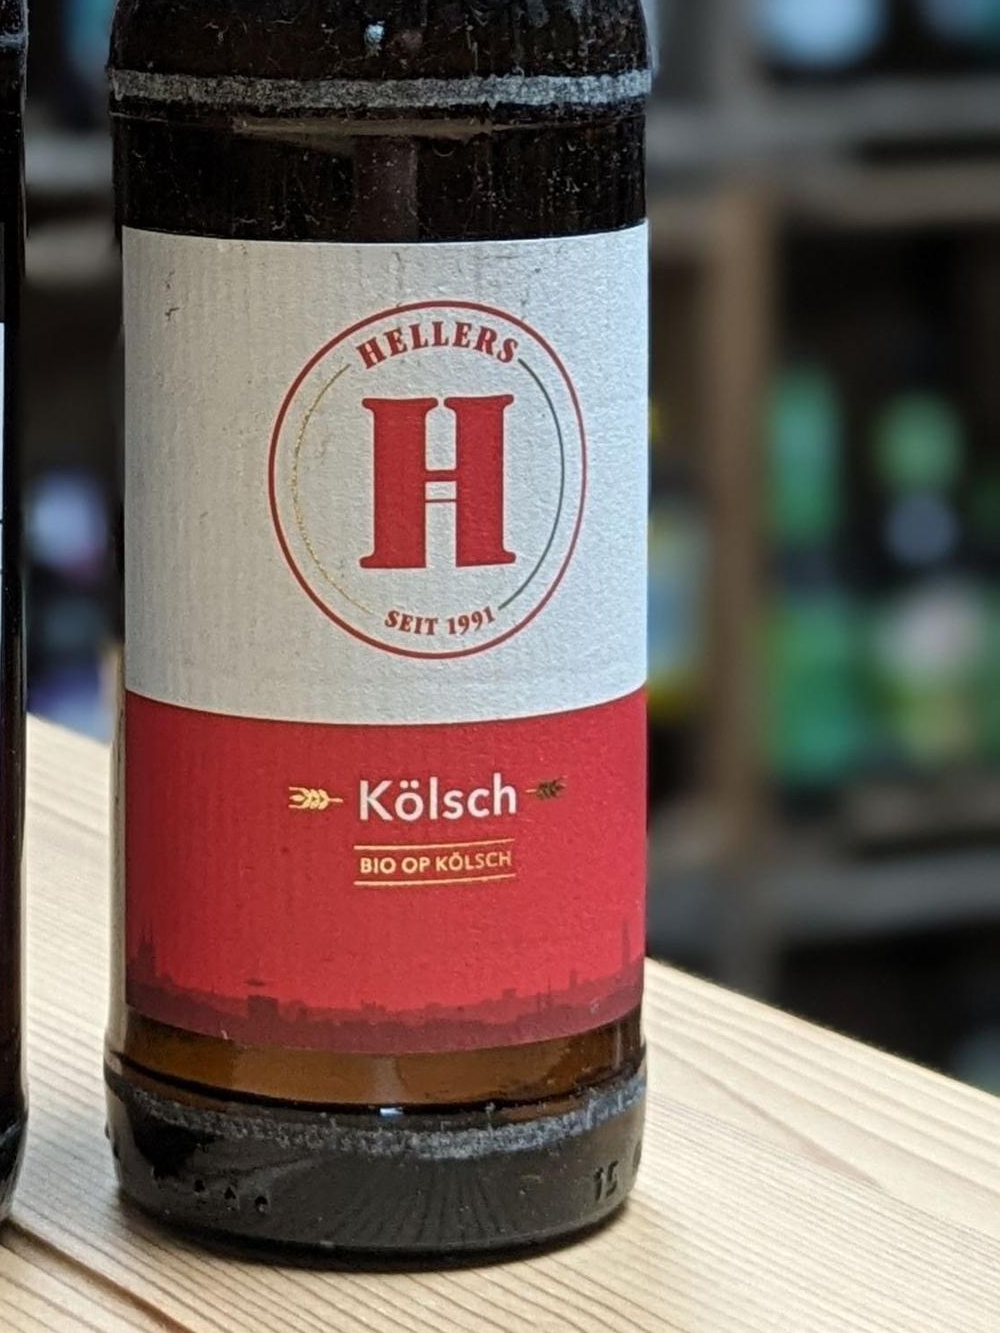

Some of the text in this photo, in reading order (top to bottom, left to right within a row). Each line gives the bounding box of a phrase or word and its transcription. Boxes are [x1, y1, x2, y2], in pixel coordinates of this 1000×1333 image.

[355, 320, 519, 369] HELLERS
[359, 394, 517, 569] H
[384, 606, 496, 636] SEIT 1991
[359, 772, 517, 822] Kölsch
[360, 851, 512, 874] BIO OP KÖLSCH
